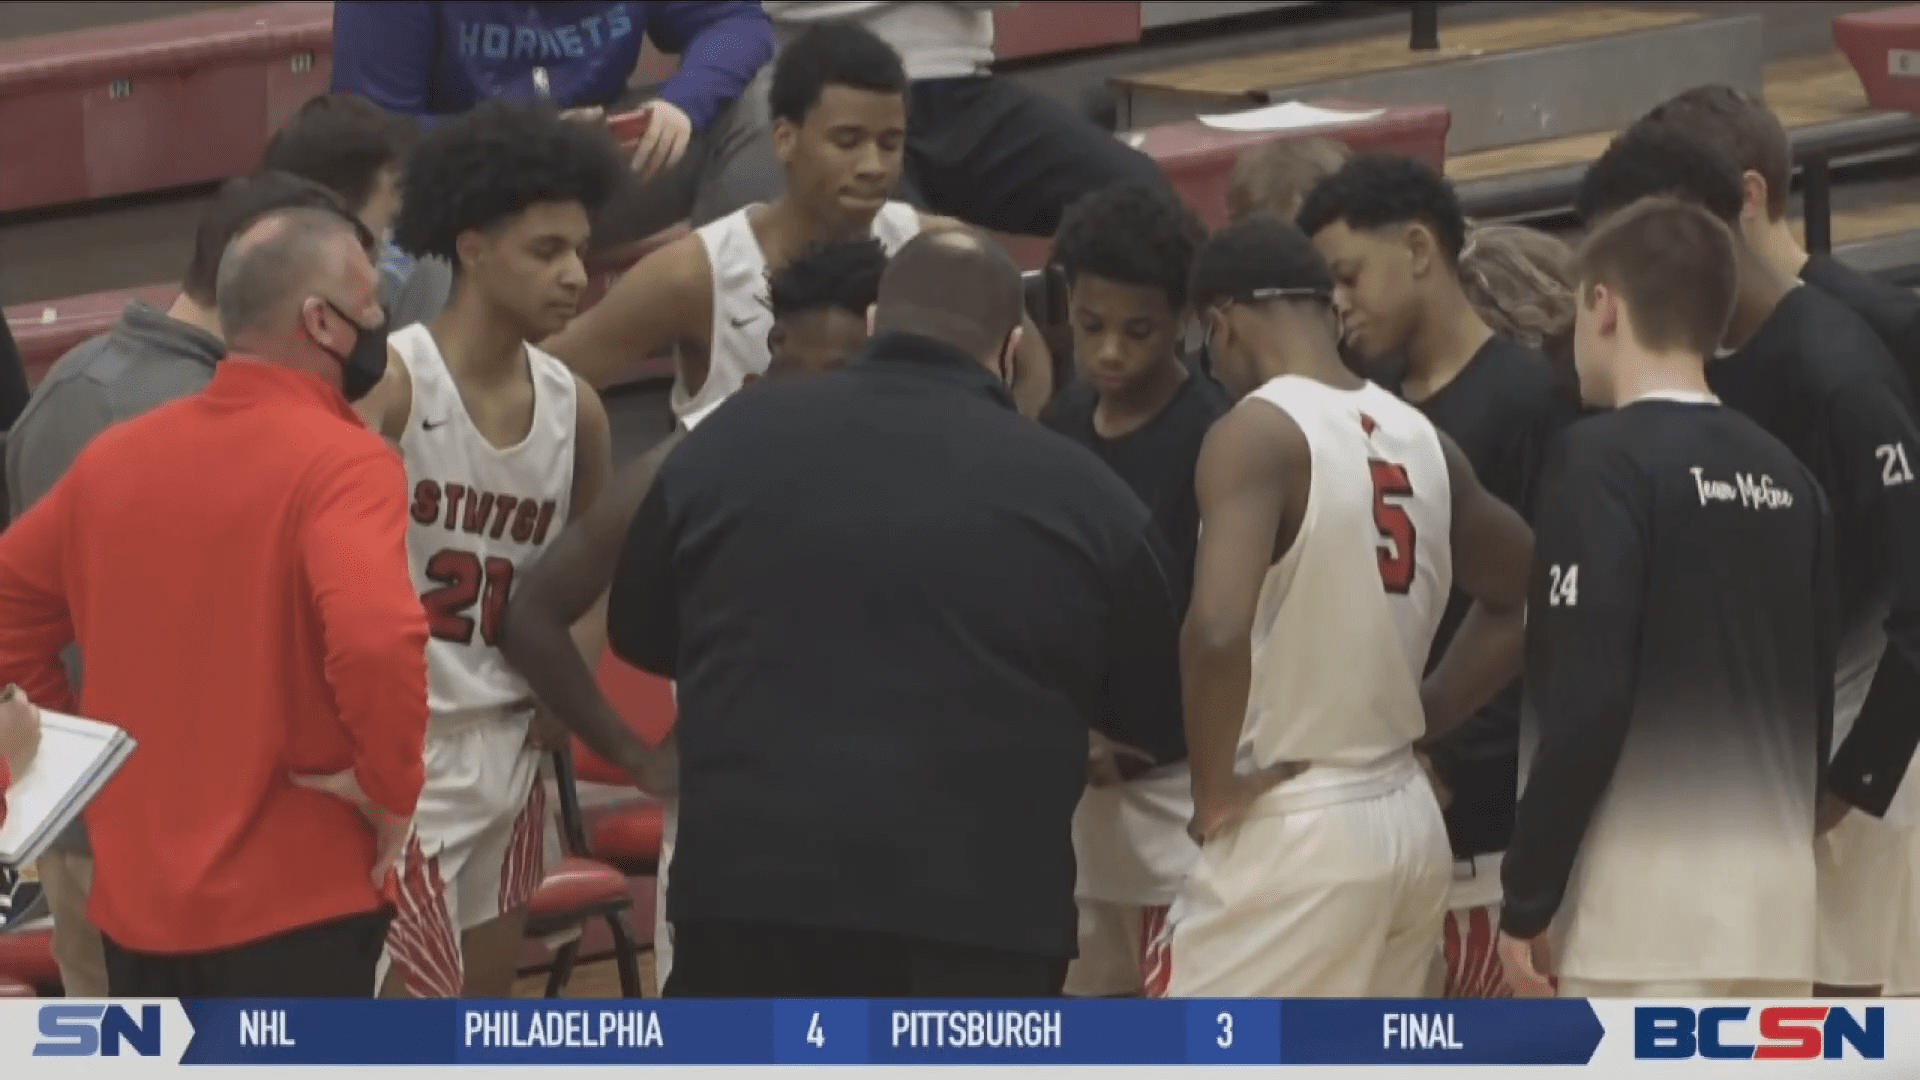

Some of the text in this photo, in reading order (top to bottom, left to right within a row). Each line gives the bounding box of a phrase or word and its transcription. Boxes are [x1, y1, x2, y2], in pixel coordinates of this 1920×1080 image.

[459, 3, 632, 59] HORNETS
[1875, 441, 1914, 486] 21
[1689, 465, 1794, 511] Team McGee
[1367, 457, 1416, 594] 5
[1549, 564, 1579, 606] 24
